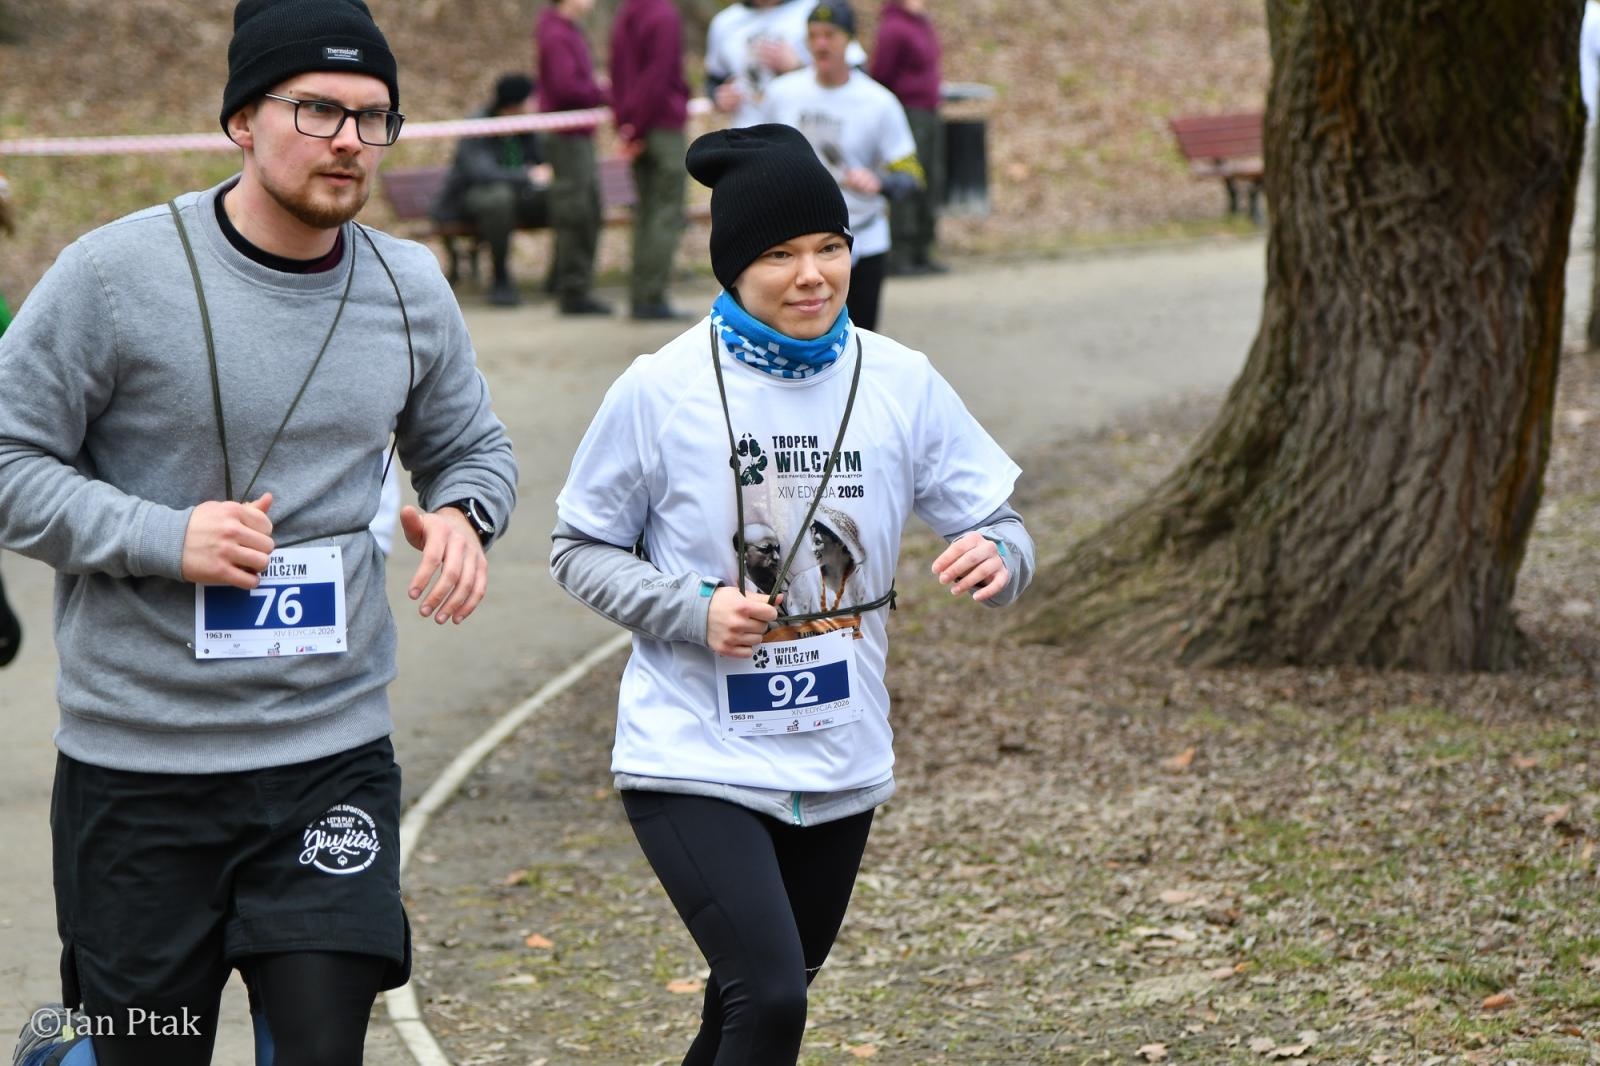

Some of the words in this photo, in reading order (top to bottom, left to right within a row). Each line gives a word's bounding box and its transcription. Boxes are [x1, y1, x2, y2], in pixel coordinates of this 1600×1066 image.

[772, 435, 818, 449] TROPEM
[778, 486, 795, 498] XIV
[798, 485, 836, 498] EDYJA
[838, 485, 865, 499] 2026
[250, 586, 303, 626] 76
[318, 627, 336, 635] 2026
[774, 646, 798, 655] TROPEM
[775, 650, 820, 666] WILCZYM
[768, 671, 818, 708] 92
[833, 700, 850, 709] 2026
